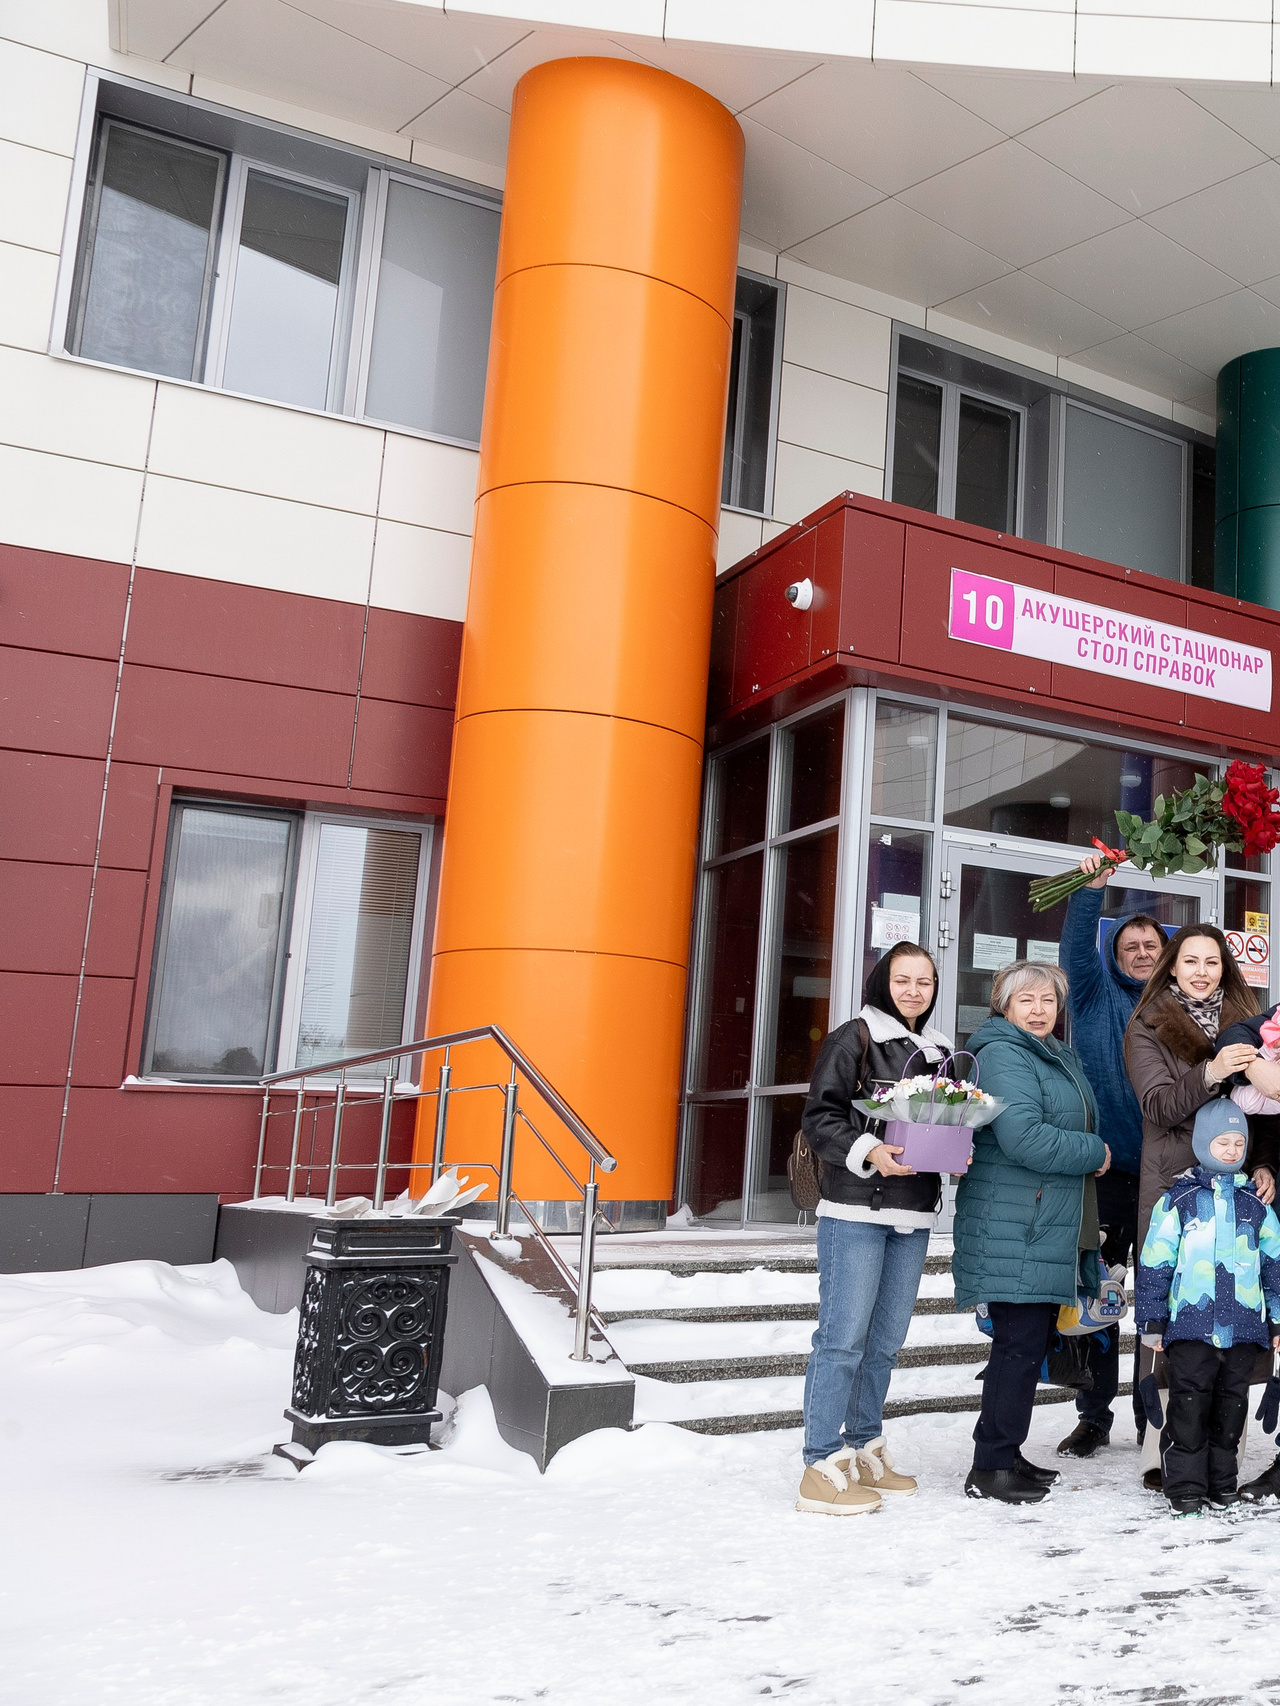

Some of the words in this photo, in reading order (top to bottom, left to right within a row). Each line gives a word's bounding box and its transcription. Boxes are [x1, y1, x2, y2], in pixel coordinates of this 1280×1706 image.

[962, 590, 1004, 631] 10
[1021, 598, 1155, 648] АКУШЕРСКИЙ
[1160, 633, 1264, 675] СТАЦИОНАР
[1077, 636, 1128, 667] СТОЛ
[1133, 651, 1216, 689] СПРАВОК
